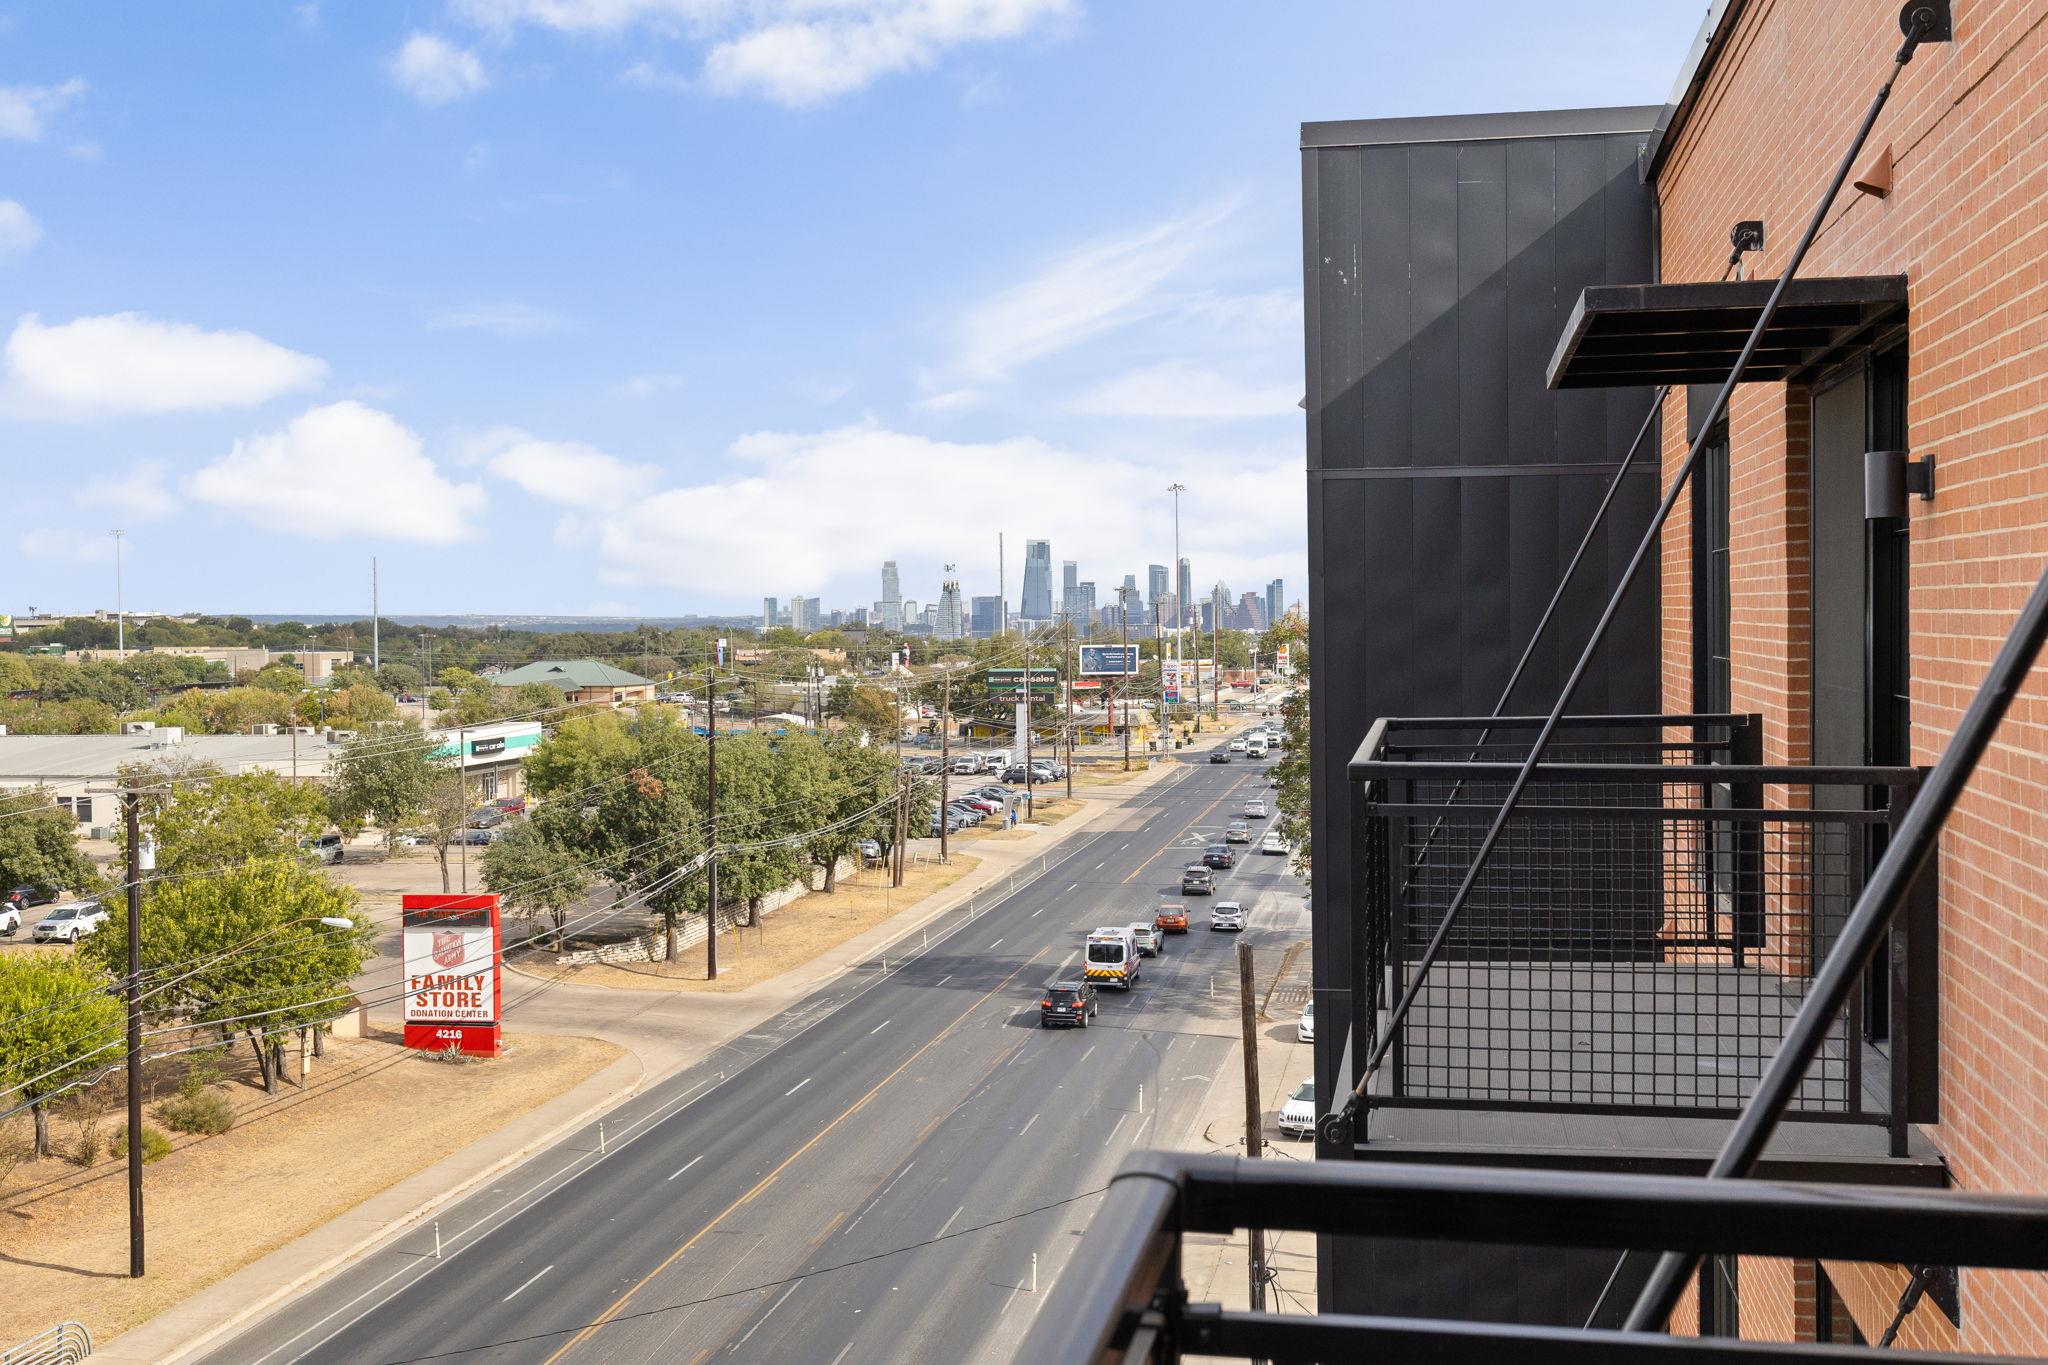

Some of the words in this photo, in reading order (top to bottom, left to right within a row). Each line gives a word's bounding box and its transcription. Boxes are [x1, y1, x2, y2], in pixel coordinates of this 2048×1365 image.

[1031, 674, 1055, 683] sales
[438, 934, 451, 946] THE
[444, 948, 461, 965] ARMY
[412, 975, 485, 990] FAMILY
[416, 992, 482, 1007] STORE
[436, 1030, 462, 1039] 4216
